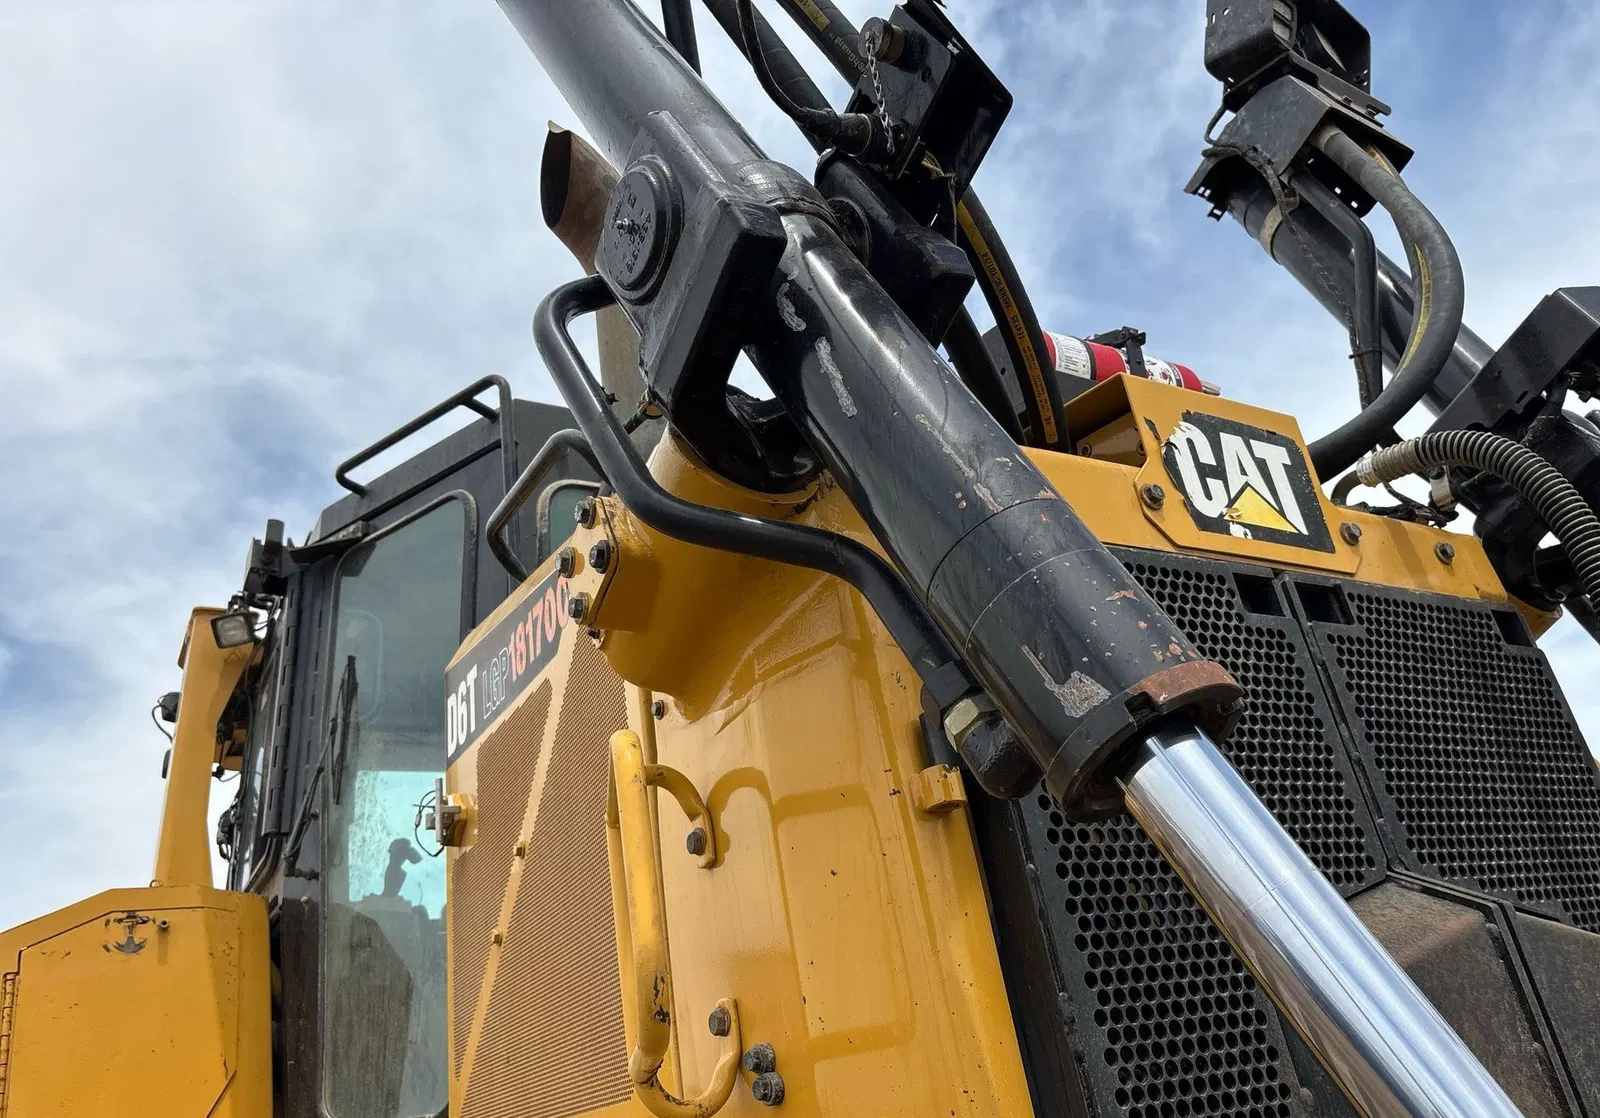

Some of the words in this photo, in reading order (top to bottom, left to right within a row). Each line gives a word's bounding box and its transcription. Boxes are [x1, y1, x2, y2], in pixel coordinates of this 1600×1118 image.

[1162, 421, 1308, 535] CAT
[448, 664, 477, 758] D6T
[482, 647, 509, 719] LGP
